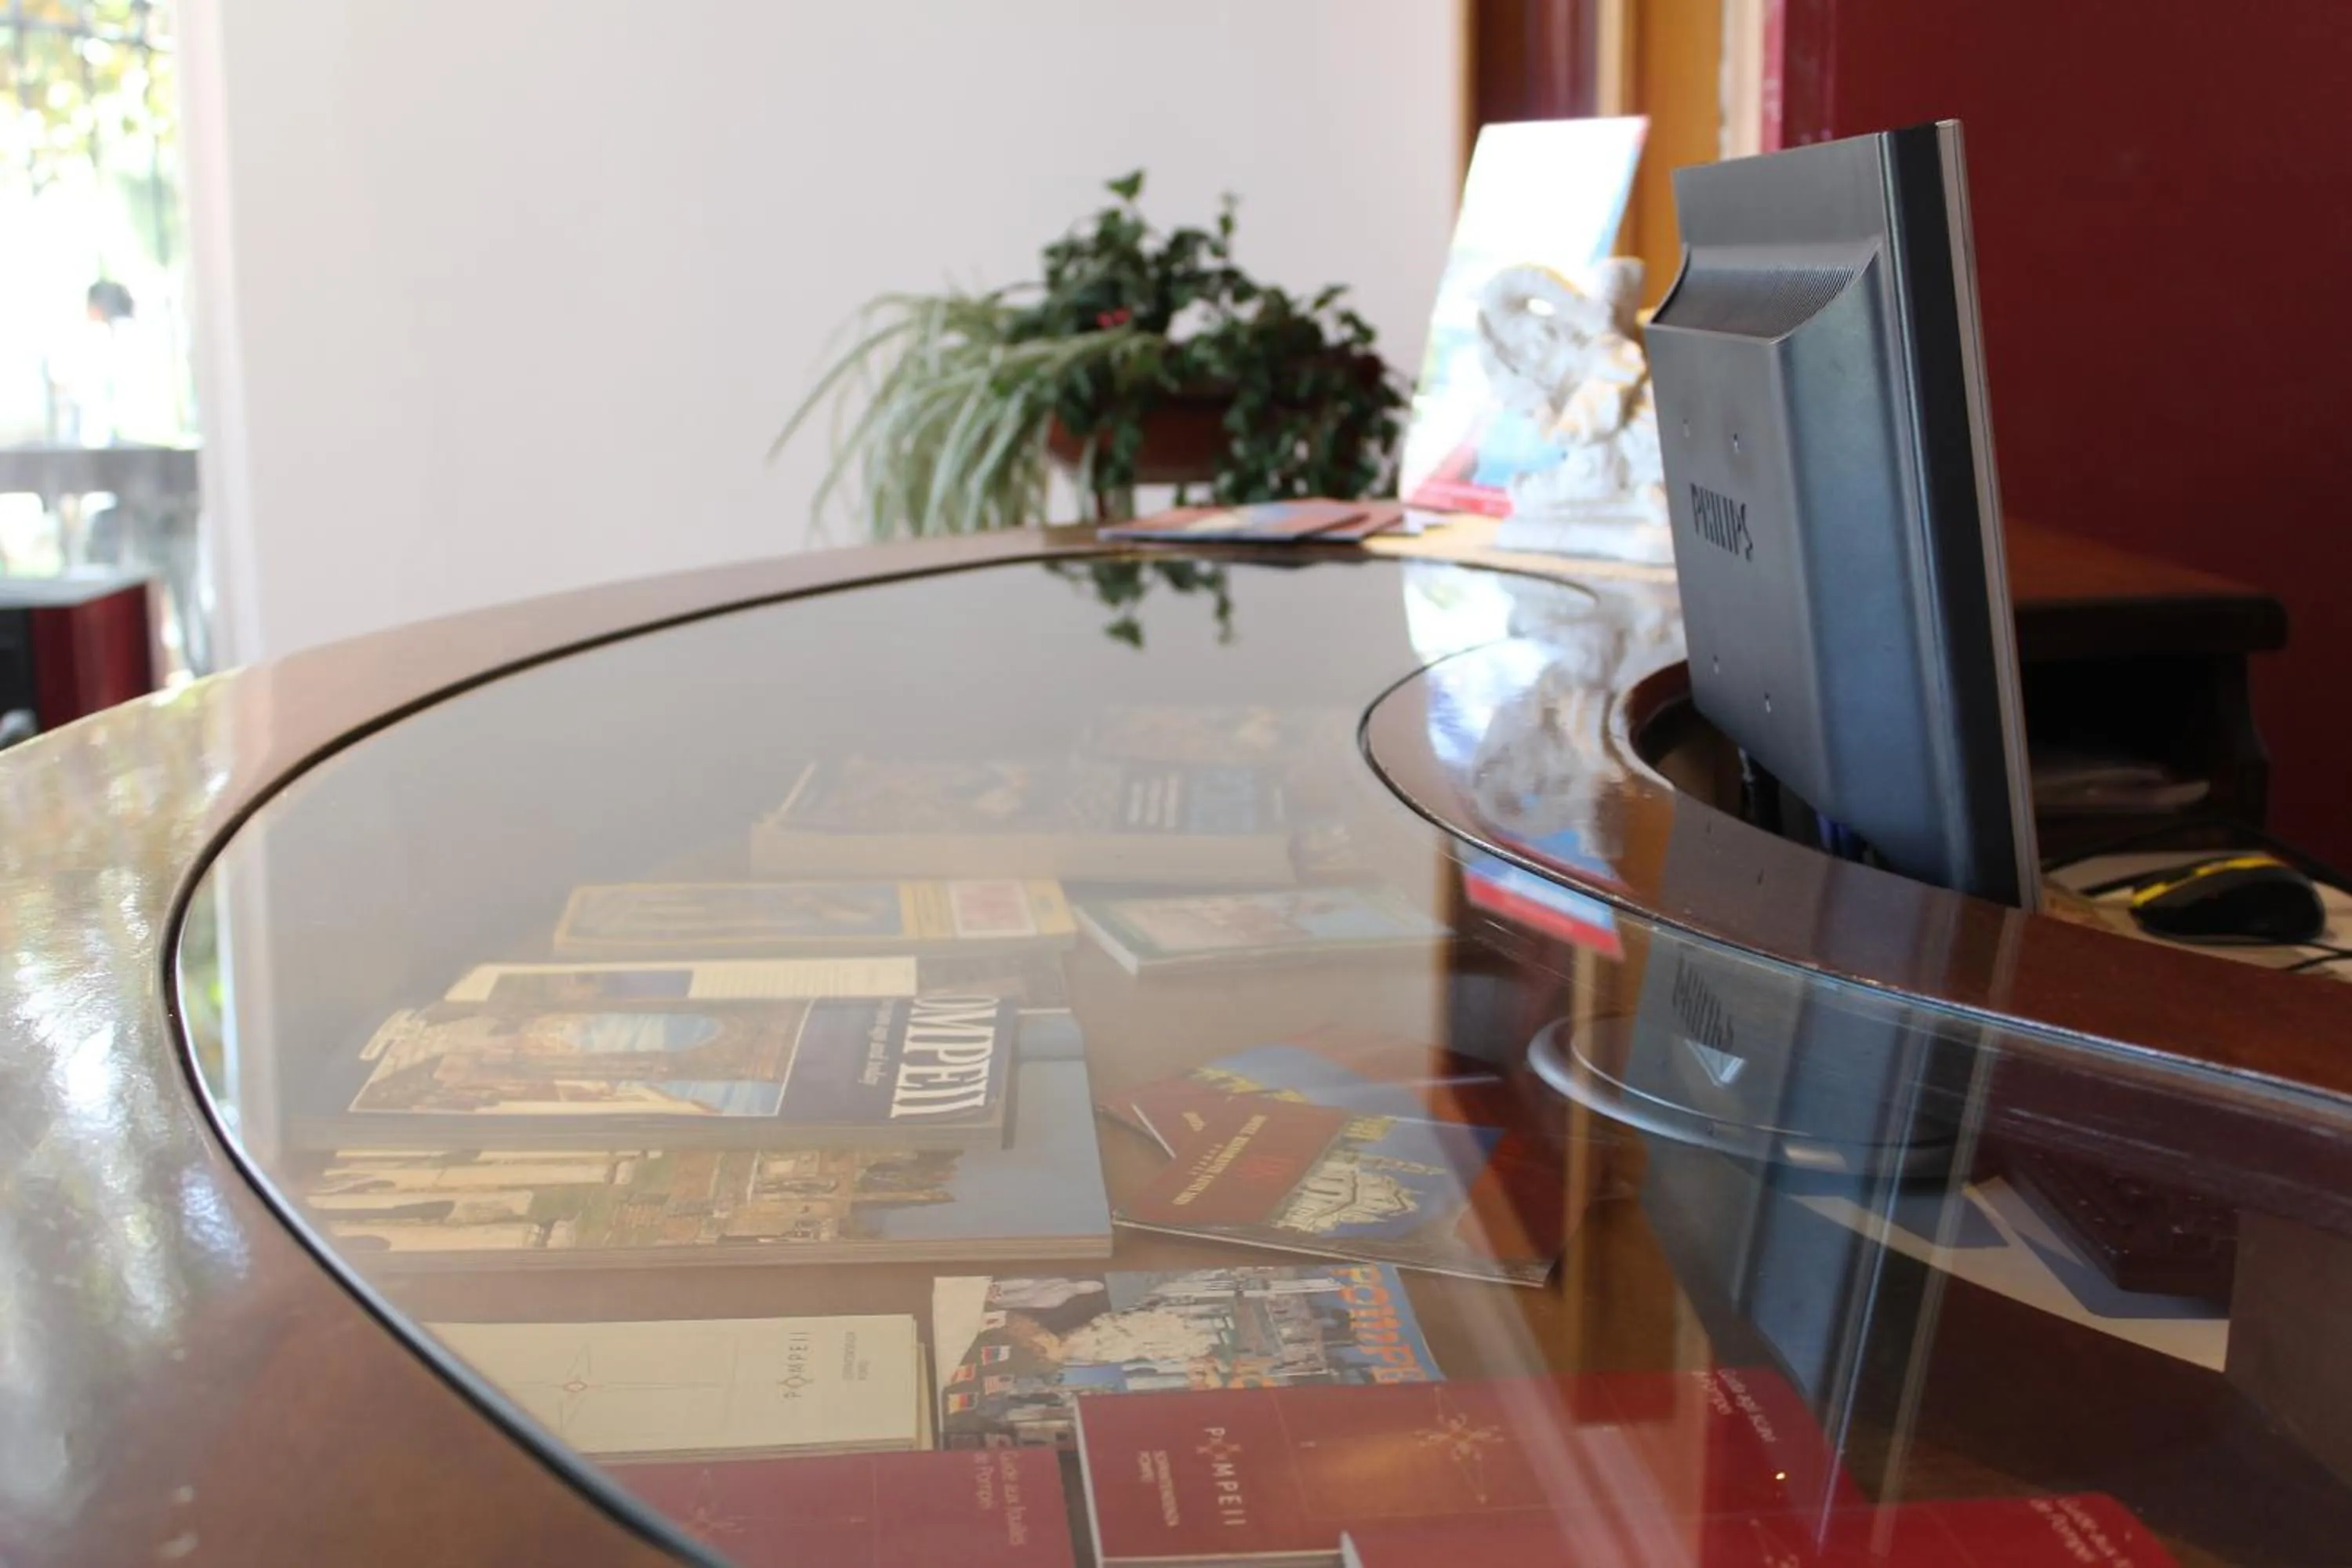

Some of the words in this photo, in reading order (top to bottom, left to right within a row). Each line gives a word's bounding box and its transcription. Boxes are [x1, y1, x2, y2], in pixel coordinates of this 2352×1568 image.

[1690, 482, 1753, 562] PHILIPS
[889, 996, 1000, 1119] OMPEII
[776, 1330, 814, 1399] POMPEII
[1196, 1427, 1248, 1525] POMPEII
